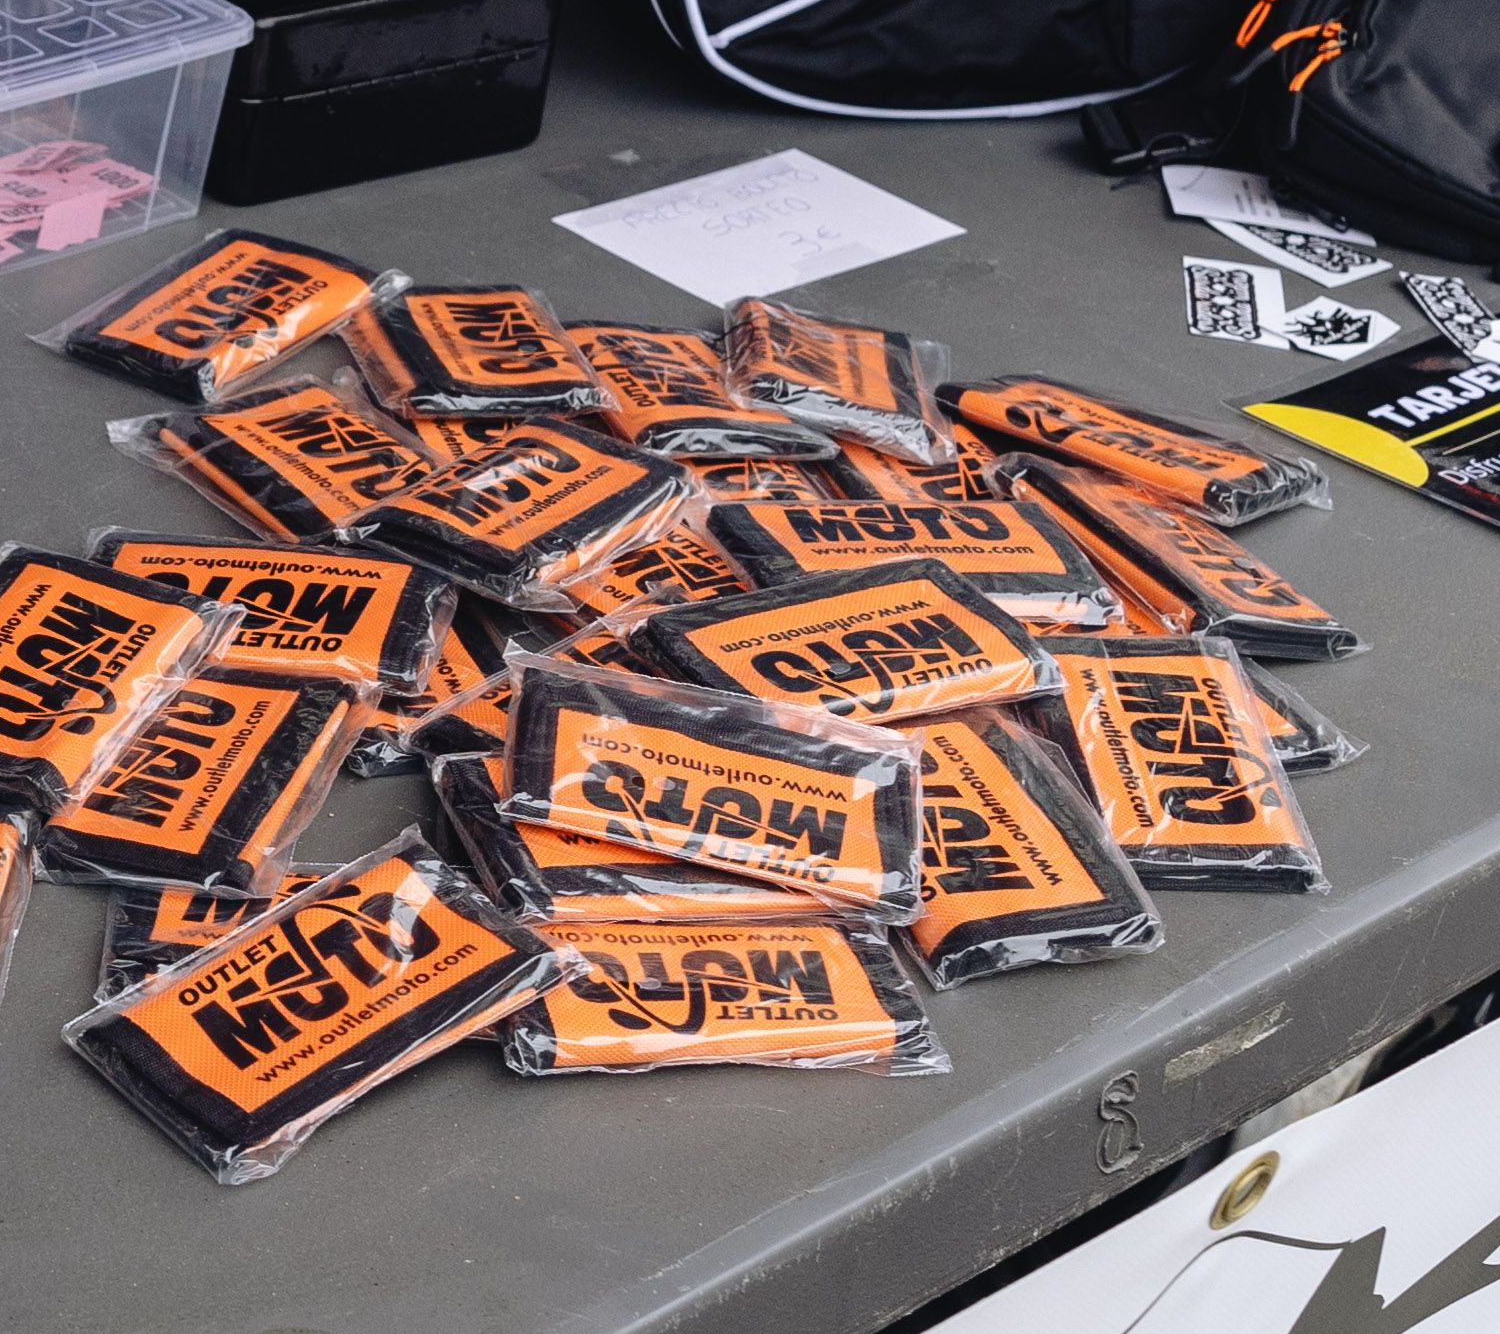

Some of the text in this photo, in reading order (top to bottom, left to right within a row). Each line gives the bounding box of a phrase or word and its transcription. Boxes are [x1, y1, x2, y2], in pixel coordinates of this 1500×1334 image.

[100, 623, 157, 683] OUTLET
[1080, 668, 1154, 829] www.outletmoto.com
[1111, 669, 1258, 825] MOTO
[1201, 678, 1246, 749] OUTLET
[582, 733, 847, 803] www.outletmoto.com
[582, 760, 848, 862] MOTO
[178, 933, 283, 1009] OUTLET
[189, 882, 443, 1071] MOTO
[254, 938, 480, 1085] www.outletmoto.com
